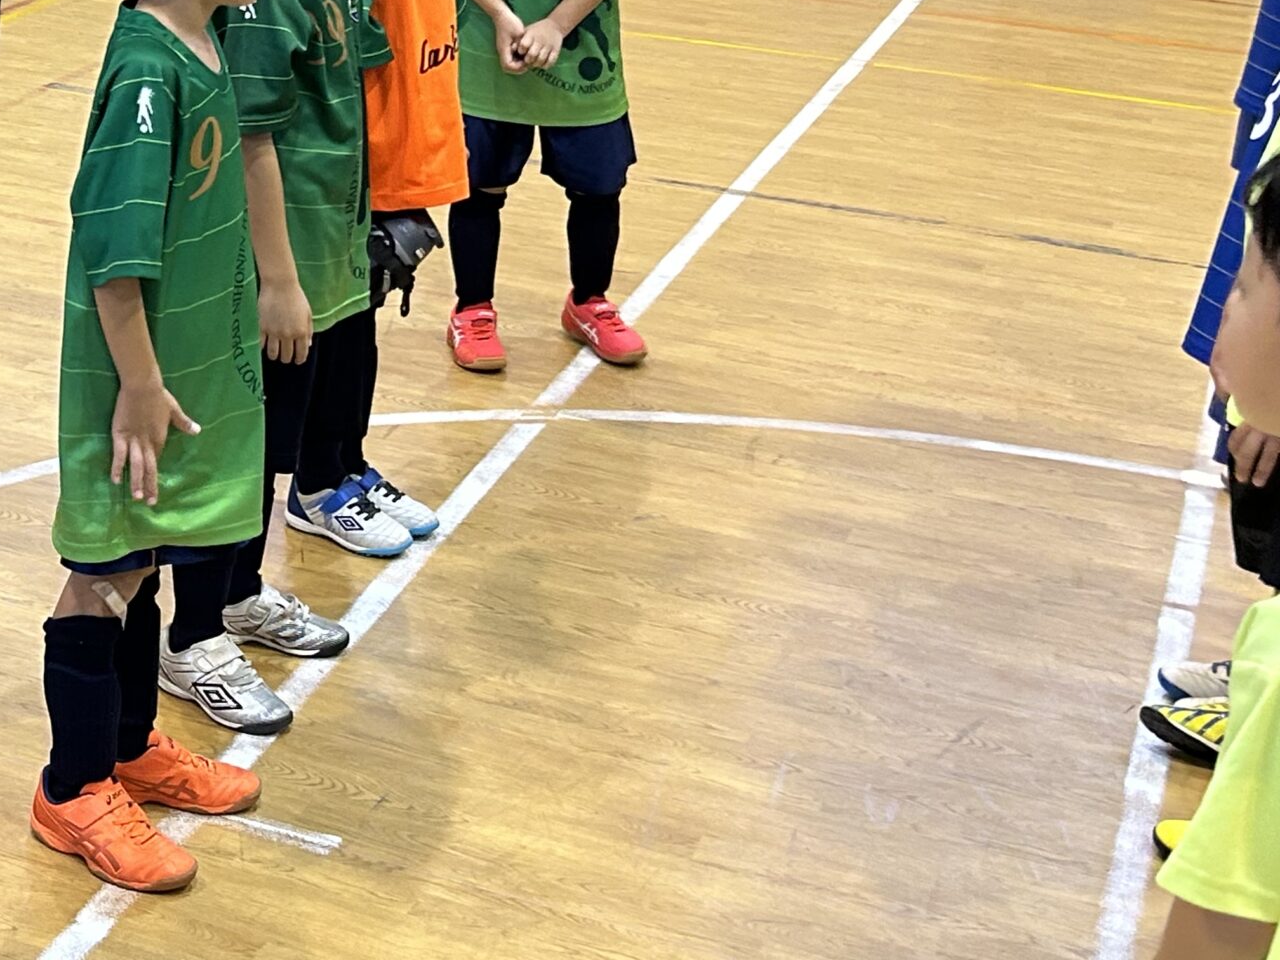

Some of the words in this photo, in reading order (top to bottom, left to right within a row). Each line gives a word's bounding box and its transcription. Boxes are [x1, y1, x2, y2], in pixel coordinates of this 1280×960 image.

[188, 115, 223, 201] 9
[232, 318, 246, 361] DEAD
[237, 361, 261, 395] NOT
